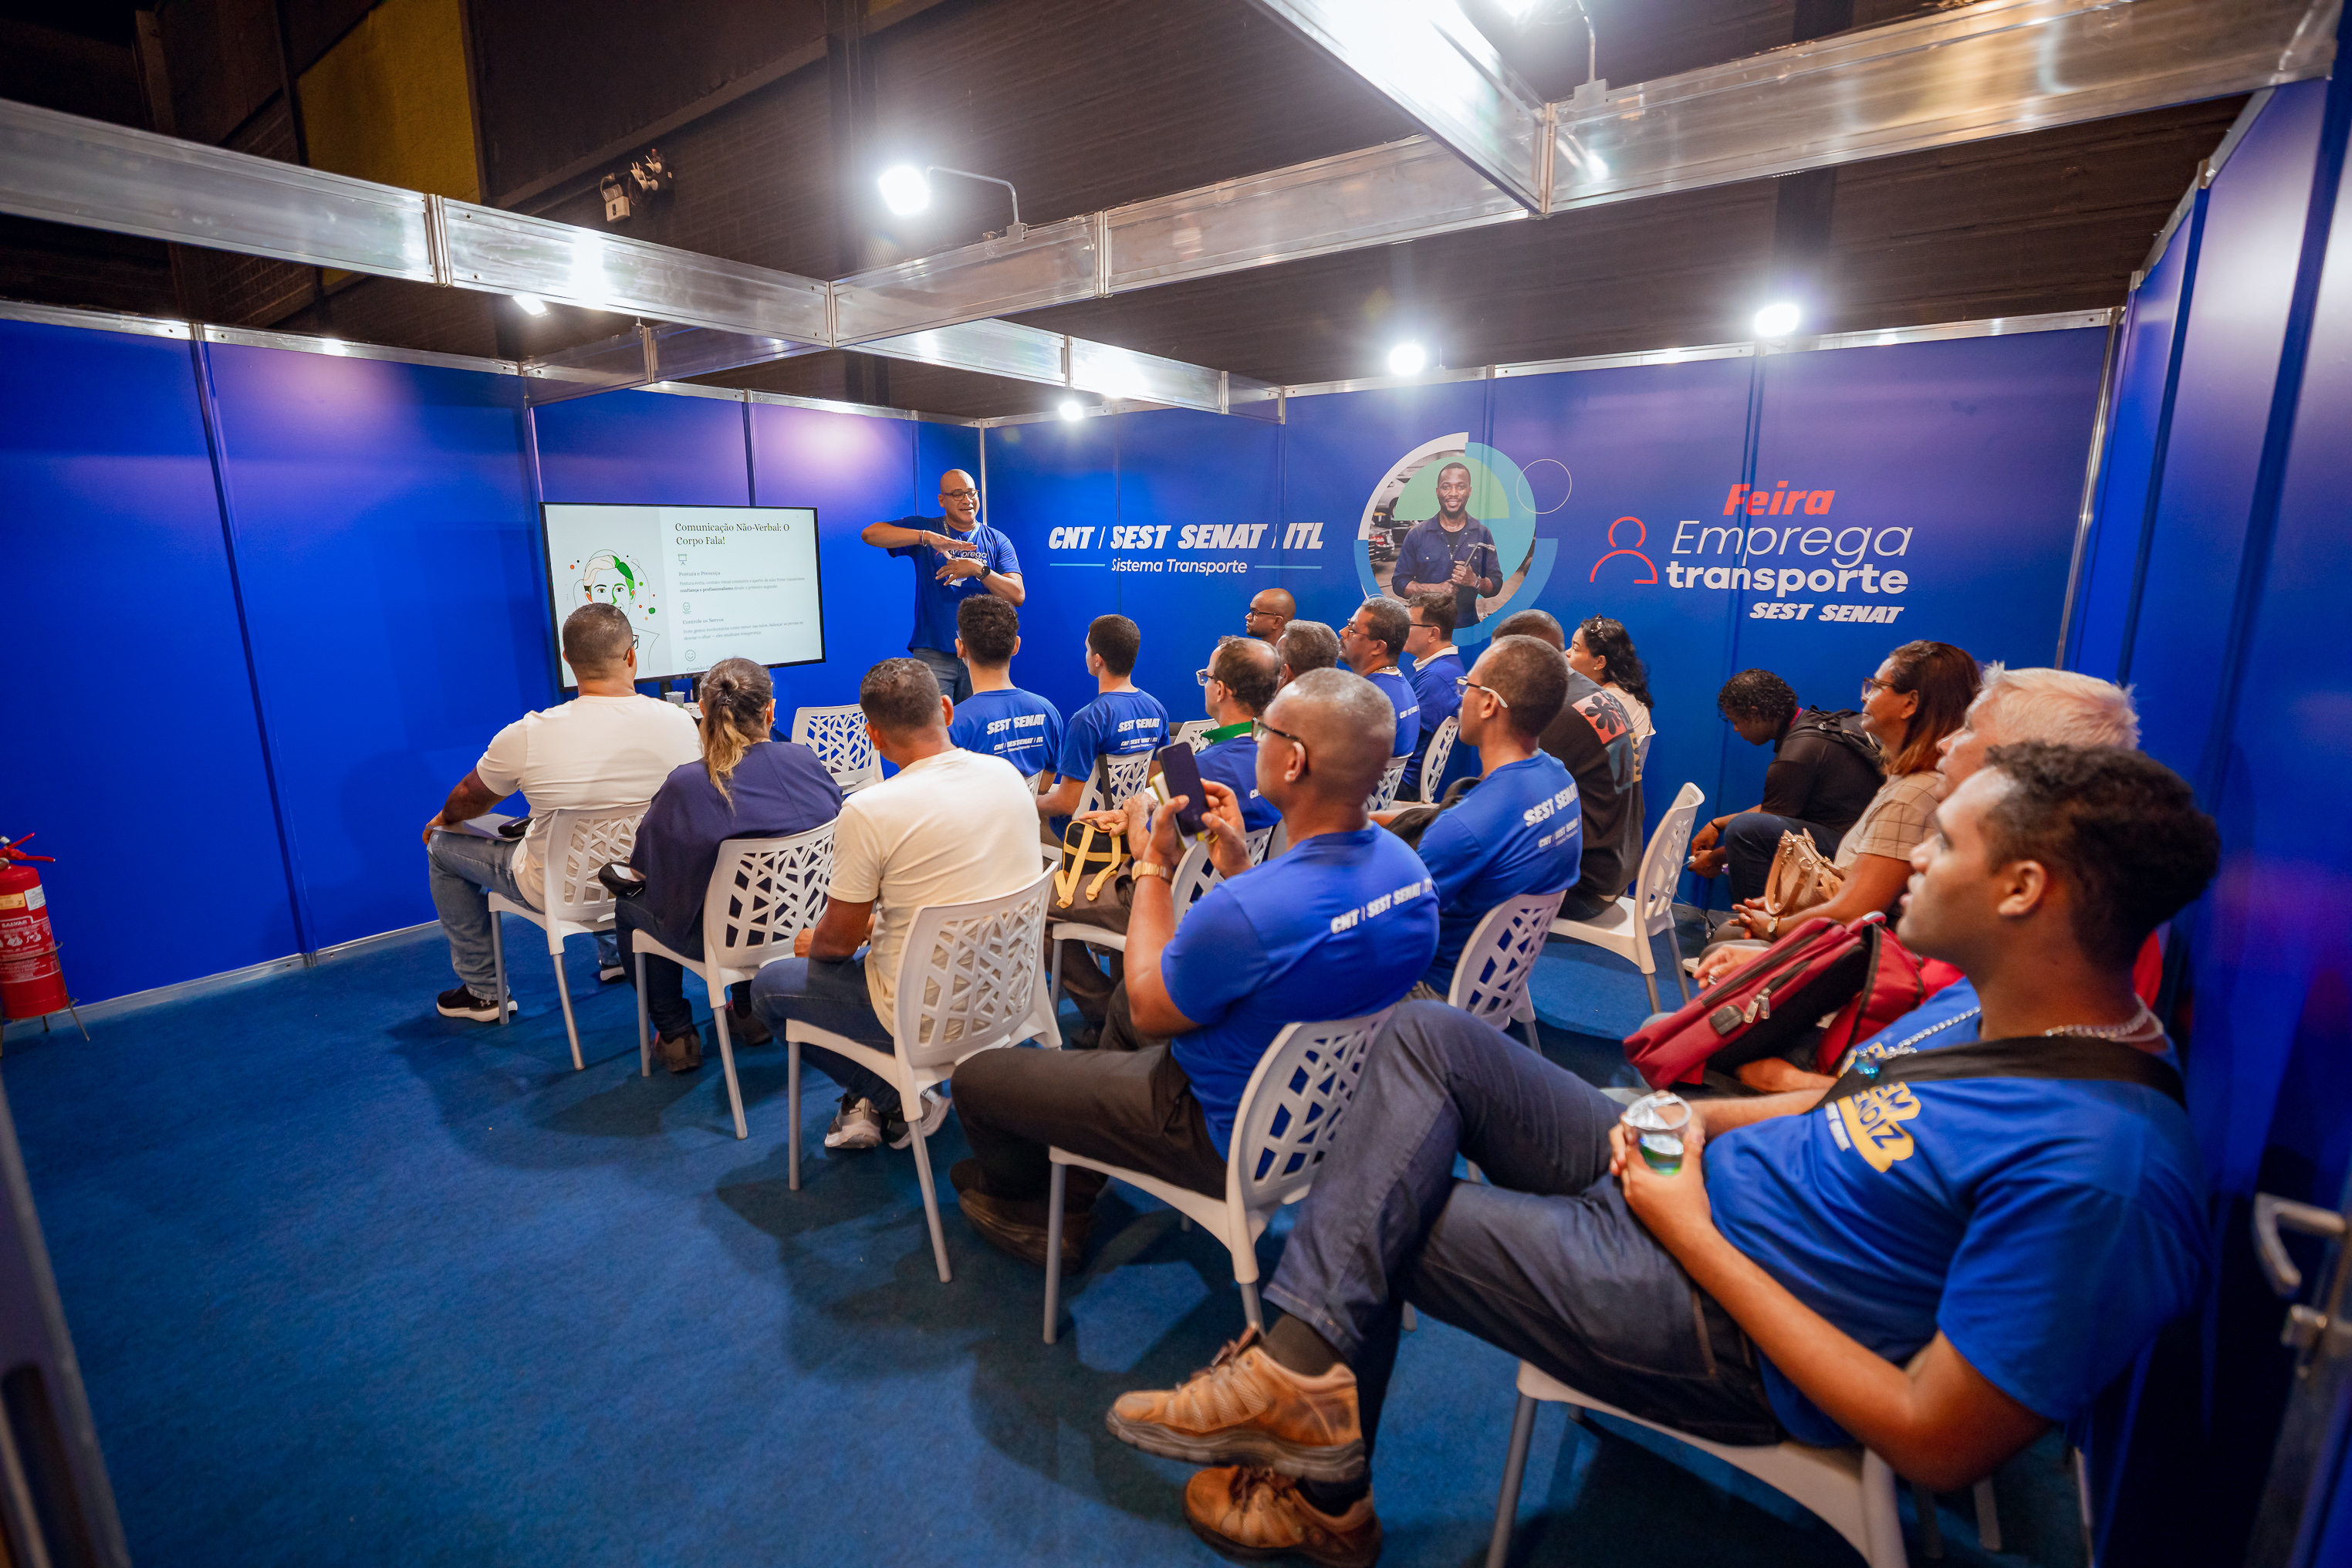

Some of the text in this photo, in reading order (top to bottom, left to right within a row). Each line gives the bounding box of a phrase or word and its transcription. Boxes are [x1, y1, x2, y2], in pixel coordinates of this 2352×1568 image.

[1722, 480, 1835, 515] Feira
[674, 522, 790, 533] Comunicação Não-Verbal: O
[1048, 522, 1323, 549] CNT SEST SENAT ITL
[676, 536, 725, 546] Corpo Fala!
[1671, 520, 1914, 569] Emprega
[1111, 557, 1248, 576] Sistema Transporte
[1666, 560, 1909, 598] transporte
[1749, 602, 1905, 623] SEST SENAT
[987, 714, 1046, 735] SEST SENAT
[1117, 718, 1160, 732] SEST SENAT
[1523, 798, 1555, 827] SEST
[1330, 908, 1360, 934] CNT
[1367, 894, 1391, 918] SEST
[1393, 882, 1421, 905] SENAT
